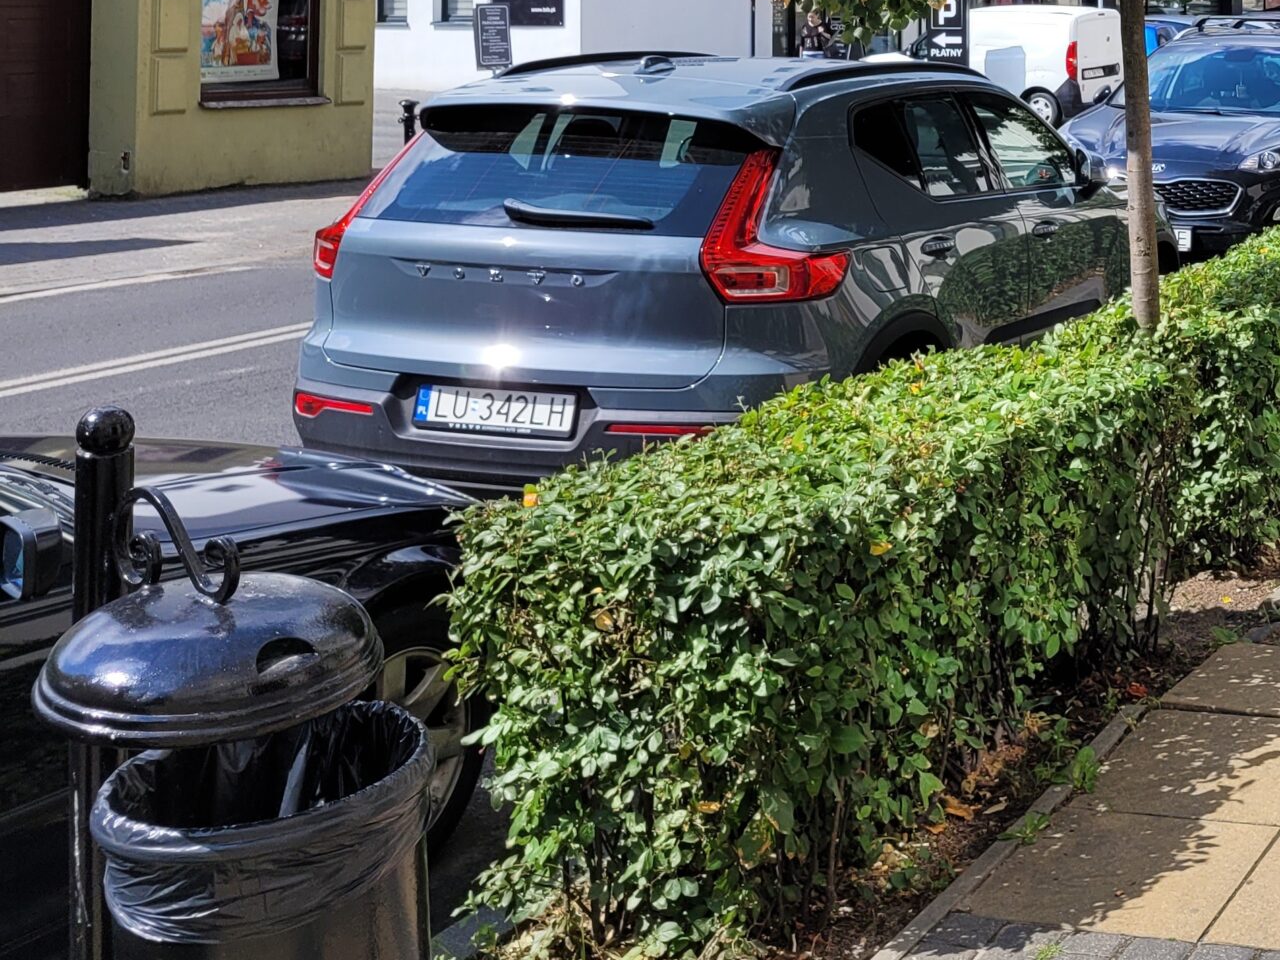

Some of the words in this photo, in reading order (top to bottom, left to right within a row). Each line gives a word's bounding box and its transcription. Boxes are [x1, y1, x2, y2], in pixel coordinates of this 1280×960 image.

[930, 48, 963, 57] PŁATNY
[417, 405, 427, 415] PL
[434, 388, 471, 419] LU
[479, 392, 567, 427] 342LH
